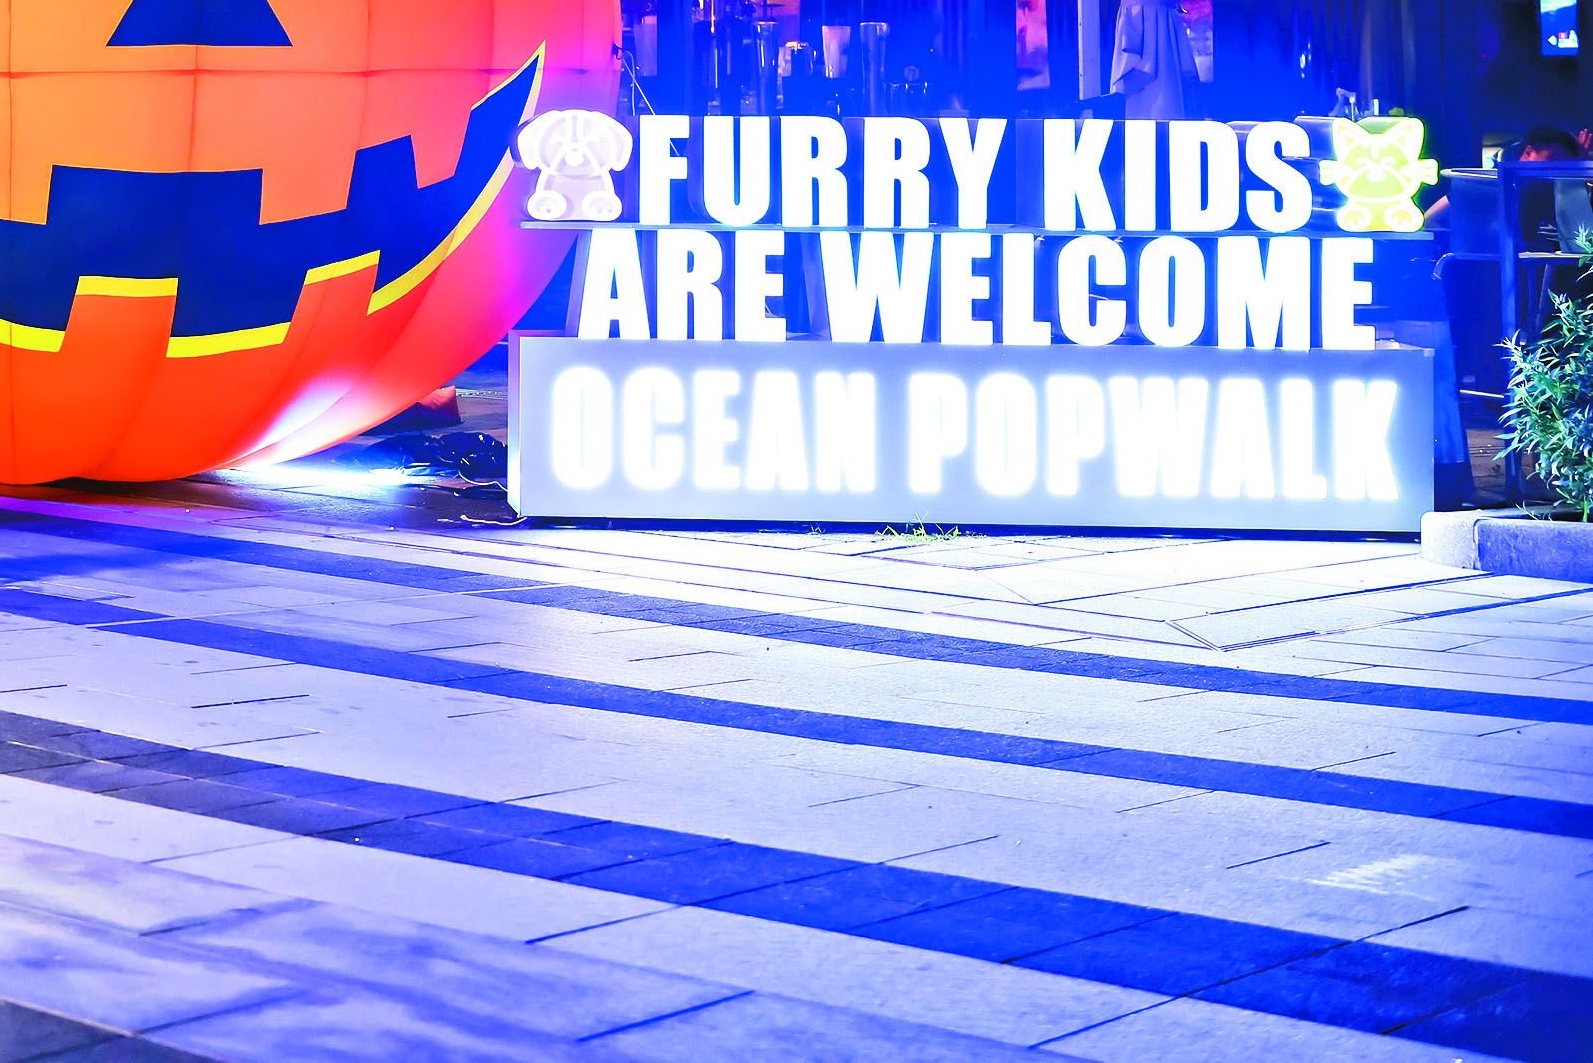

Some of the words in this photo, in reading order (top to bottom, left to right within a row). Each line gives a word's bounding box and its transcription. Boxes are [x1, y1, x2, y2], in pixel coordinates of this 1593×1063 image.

[638, 115, 1007, 229] FURRY
[1043, 119, 1312, 233] KIDS
[577, 228, 787, 342] ARE
[819, 231, 1376, 351] WELCOME
[551, 365, 876, 494] OCEAN
[907, 371, 1400, 502] POPWALK
